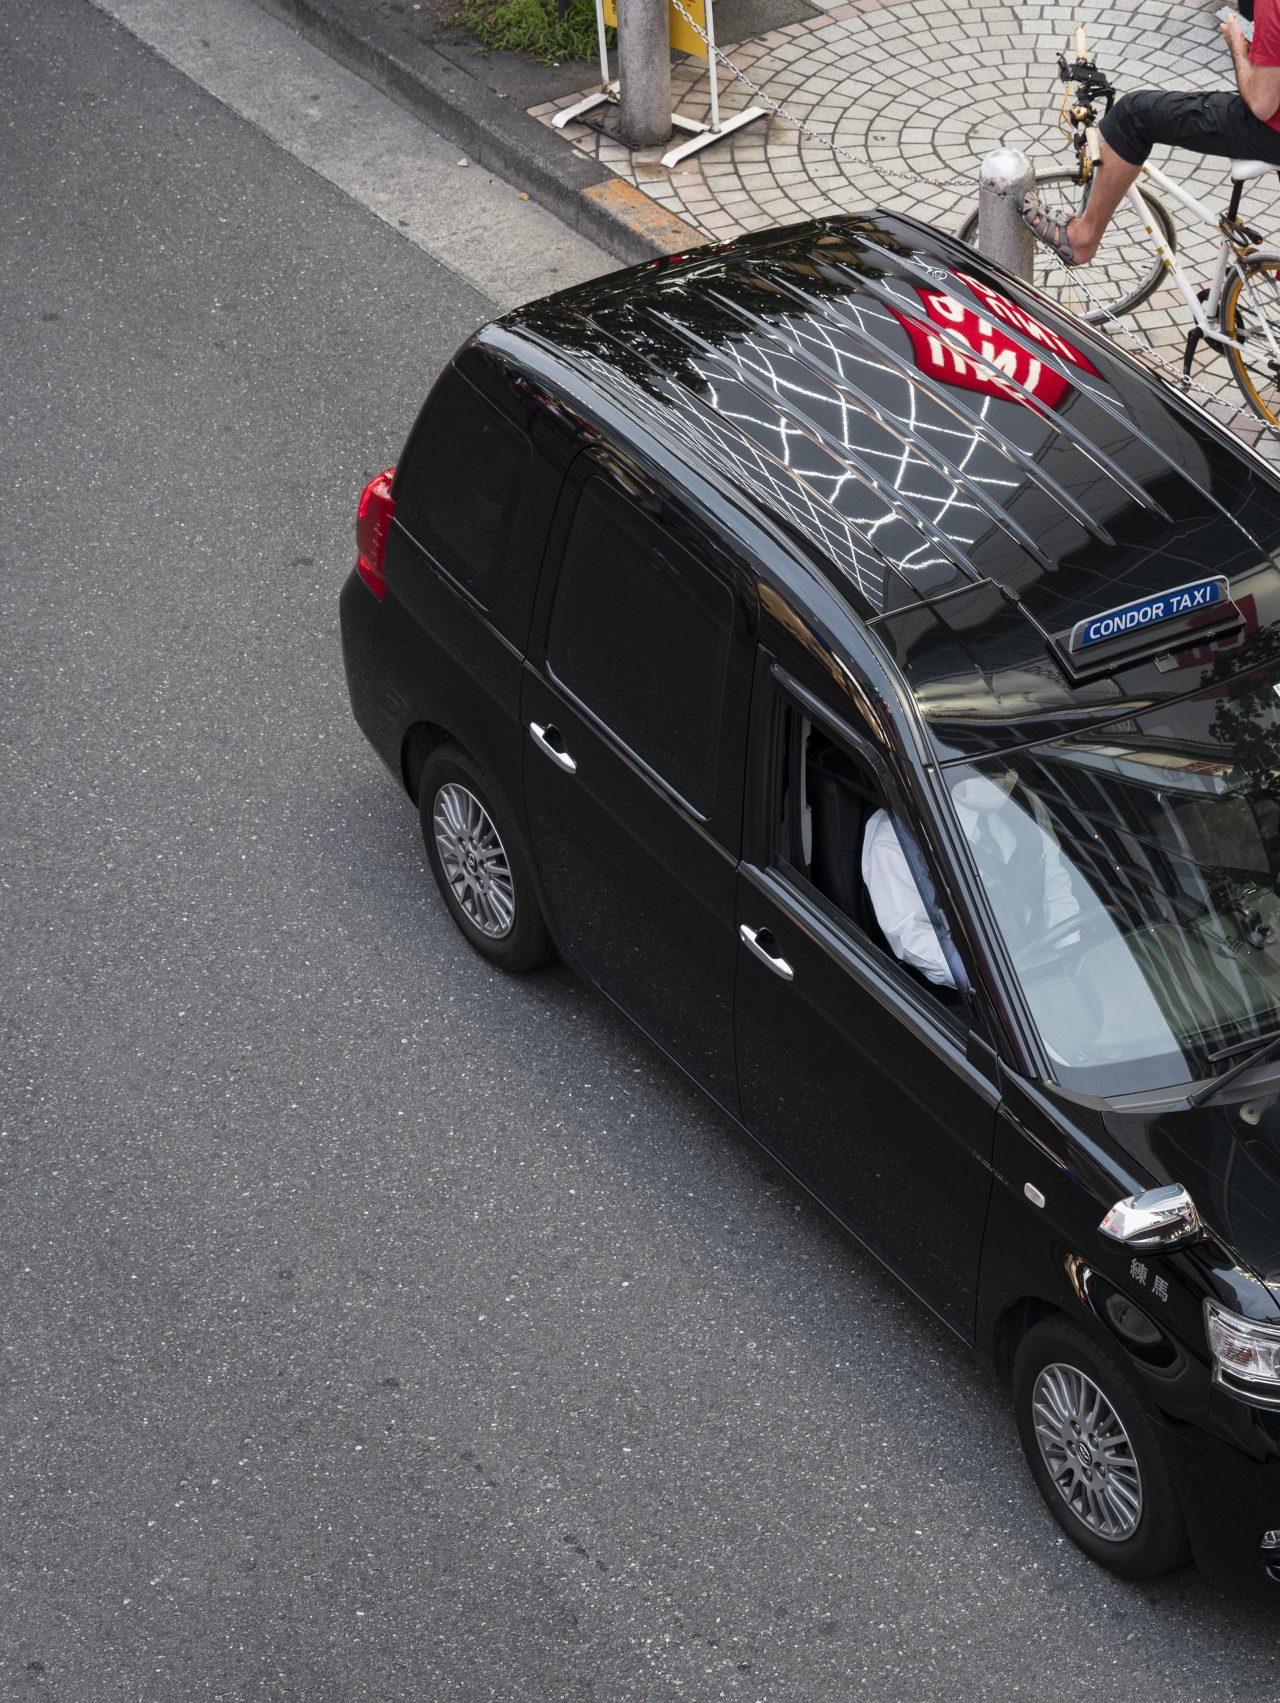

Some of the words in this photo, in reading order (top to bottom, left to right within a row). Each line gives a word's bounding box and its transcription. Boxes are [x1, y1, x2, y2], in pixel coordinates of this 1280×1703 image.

[1089, 603, 1164, 640] CONDOR
[1169, 586, 1211, 612] TAXI
[1129, 1258, 1169, 1303] 練馬
